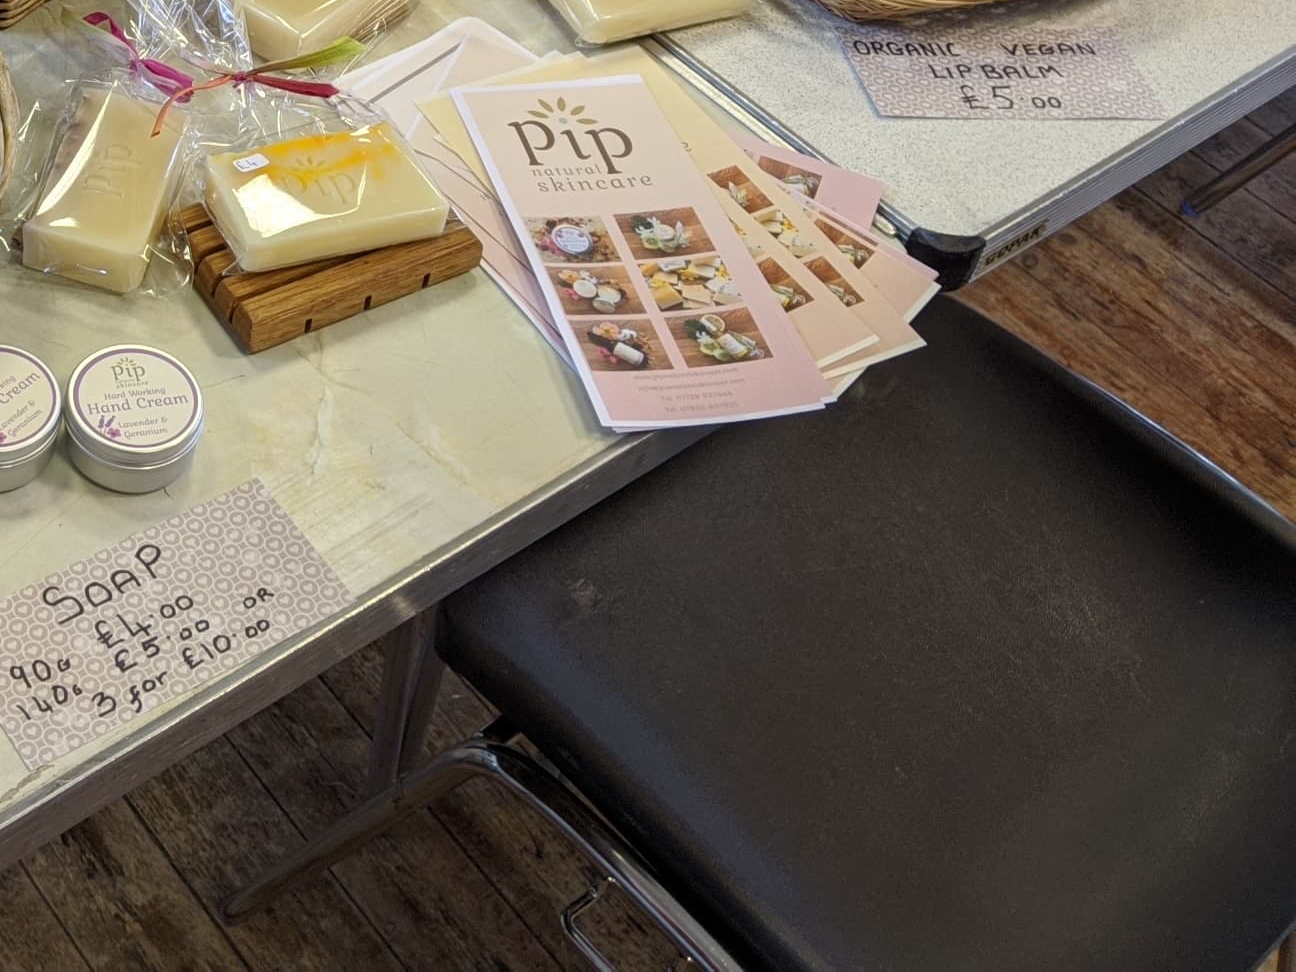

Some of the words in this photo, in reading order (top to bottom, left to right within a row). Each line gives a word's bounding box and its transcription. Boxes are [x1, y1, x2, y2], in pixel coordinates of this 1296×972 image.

[854, 40, 960, 57] ORGANIC
[1000, 41, 1096, 56] VEGAN
[928, 64, 973, 78] LIP
[982, 64, 1065, 79] BALM
[507, 120, 633, 175] pip
[531, 164, 602, 177] natural
[538, 176, 653, 193] skincare
[111, 365, 146, 382] pip
[104, 392, 126, 400] Hard
[128, 387, 166, 397] Working
[87, 399, 132, 415] Hand
[136, 393, 189, 409] Cream
[117, 419, 159, 429] Lavender
[42, 544, 162, 625] SOAP
[92, 692, 116, 717] 3
[129, 671, 168, 714] for
